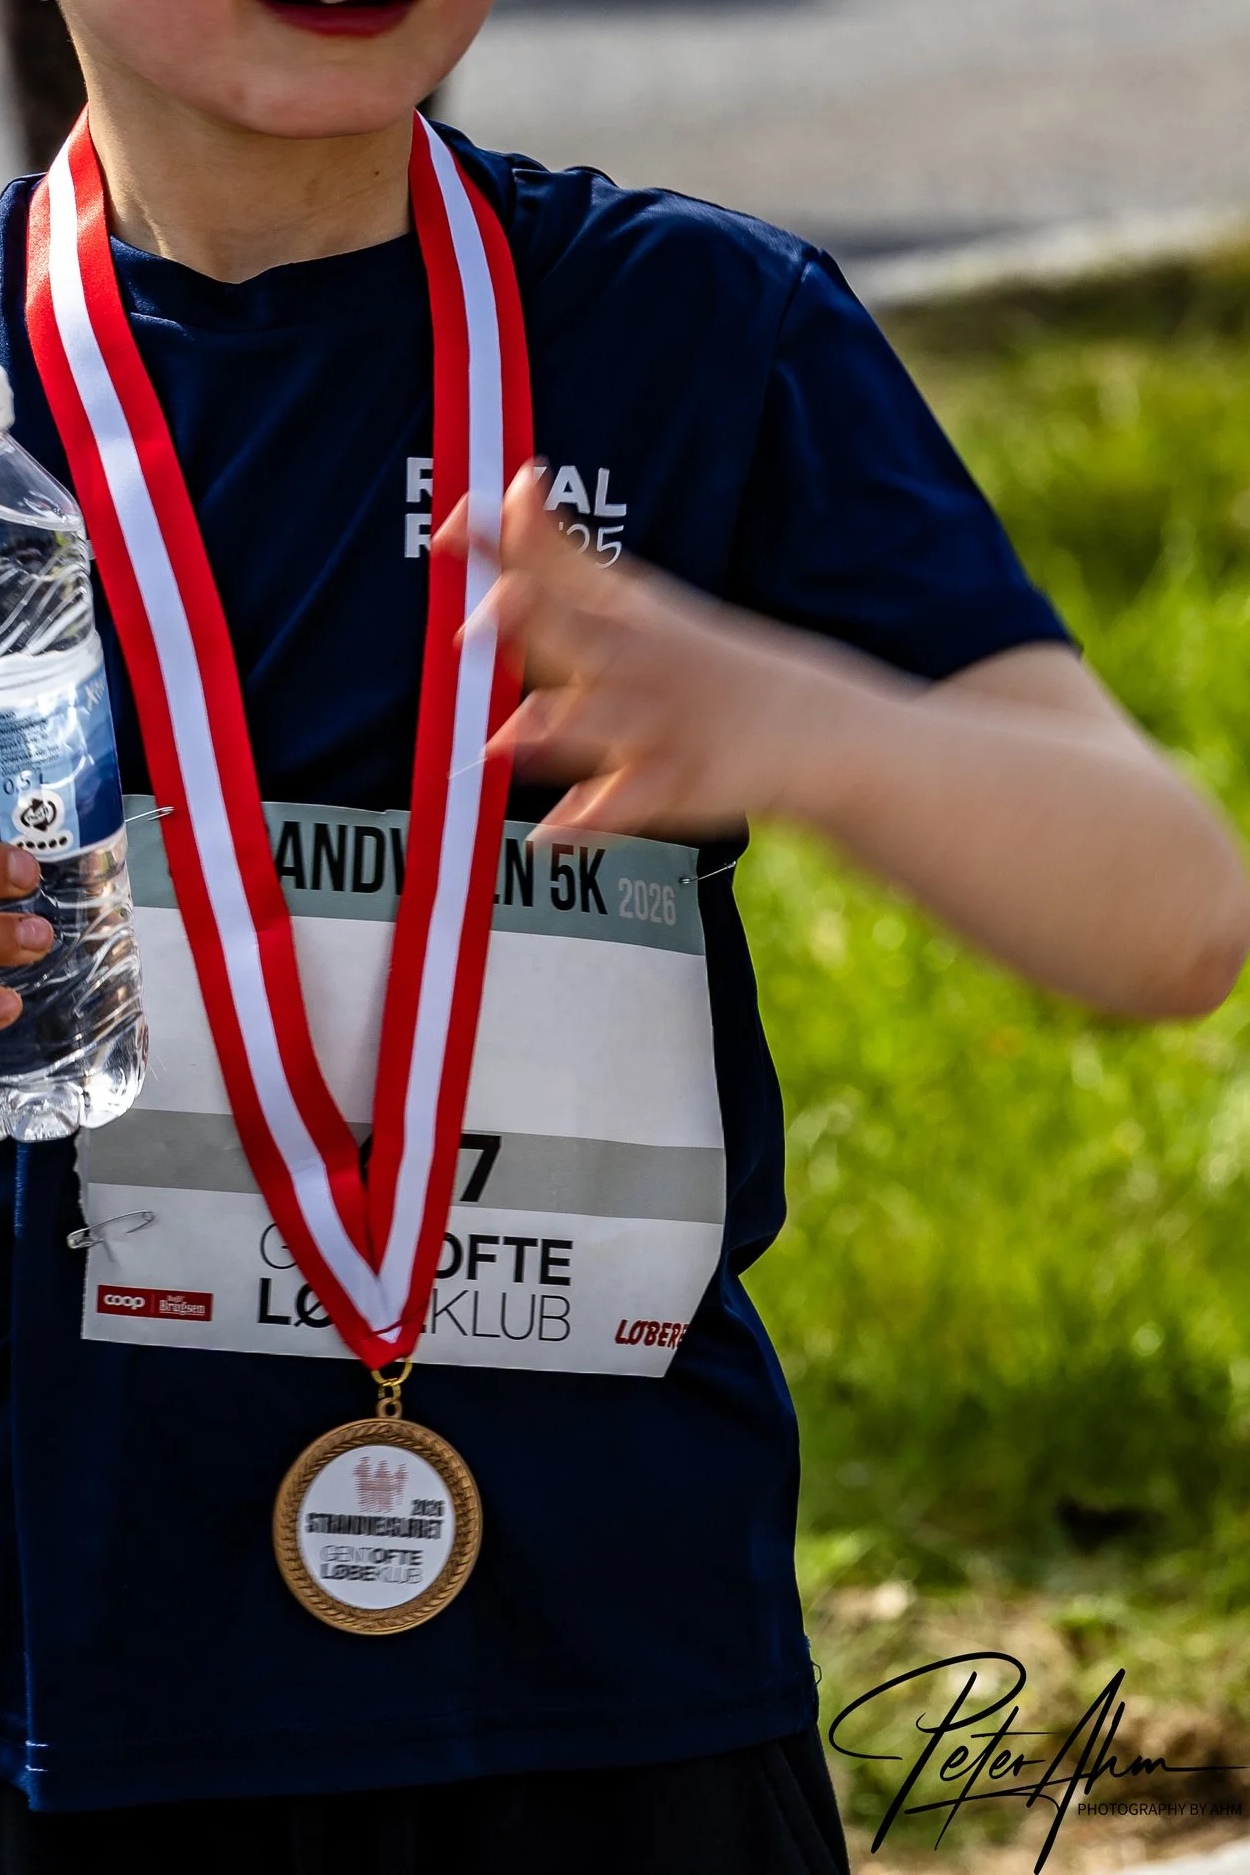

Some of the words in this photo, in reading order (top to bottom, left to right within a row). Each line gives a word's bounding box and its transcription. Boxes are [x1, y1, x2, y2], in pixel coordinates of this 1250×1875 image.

[406, 456, 627, 517] RAL
[550, 842, 608, 915] 5K
[618, 877, 676, 925] 2026
[260, 1223, 573, 1286] GFTE
[104, 1294, 145, 1310] coop
[257, 1277, 571, 1341] LØKLUB
[319, 1545, 424, 1566] GENTOFTE
[319, 1563, 424, 1584] LØBEKLUB
